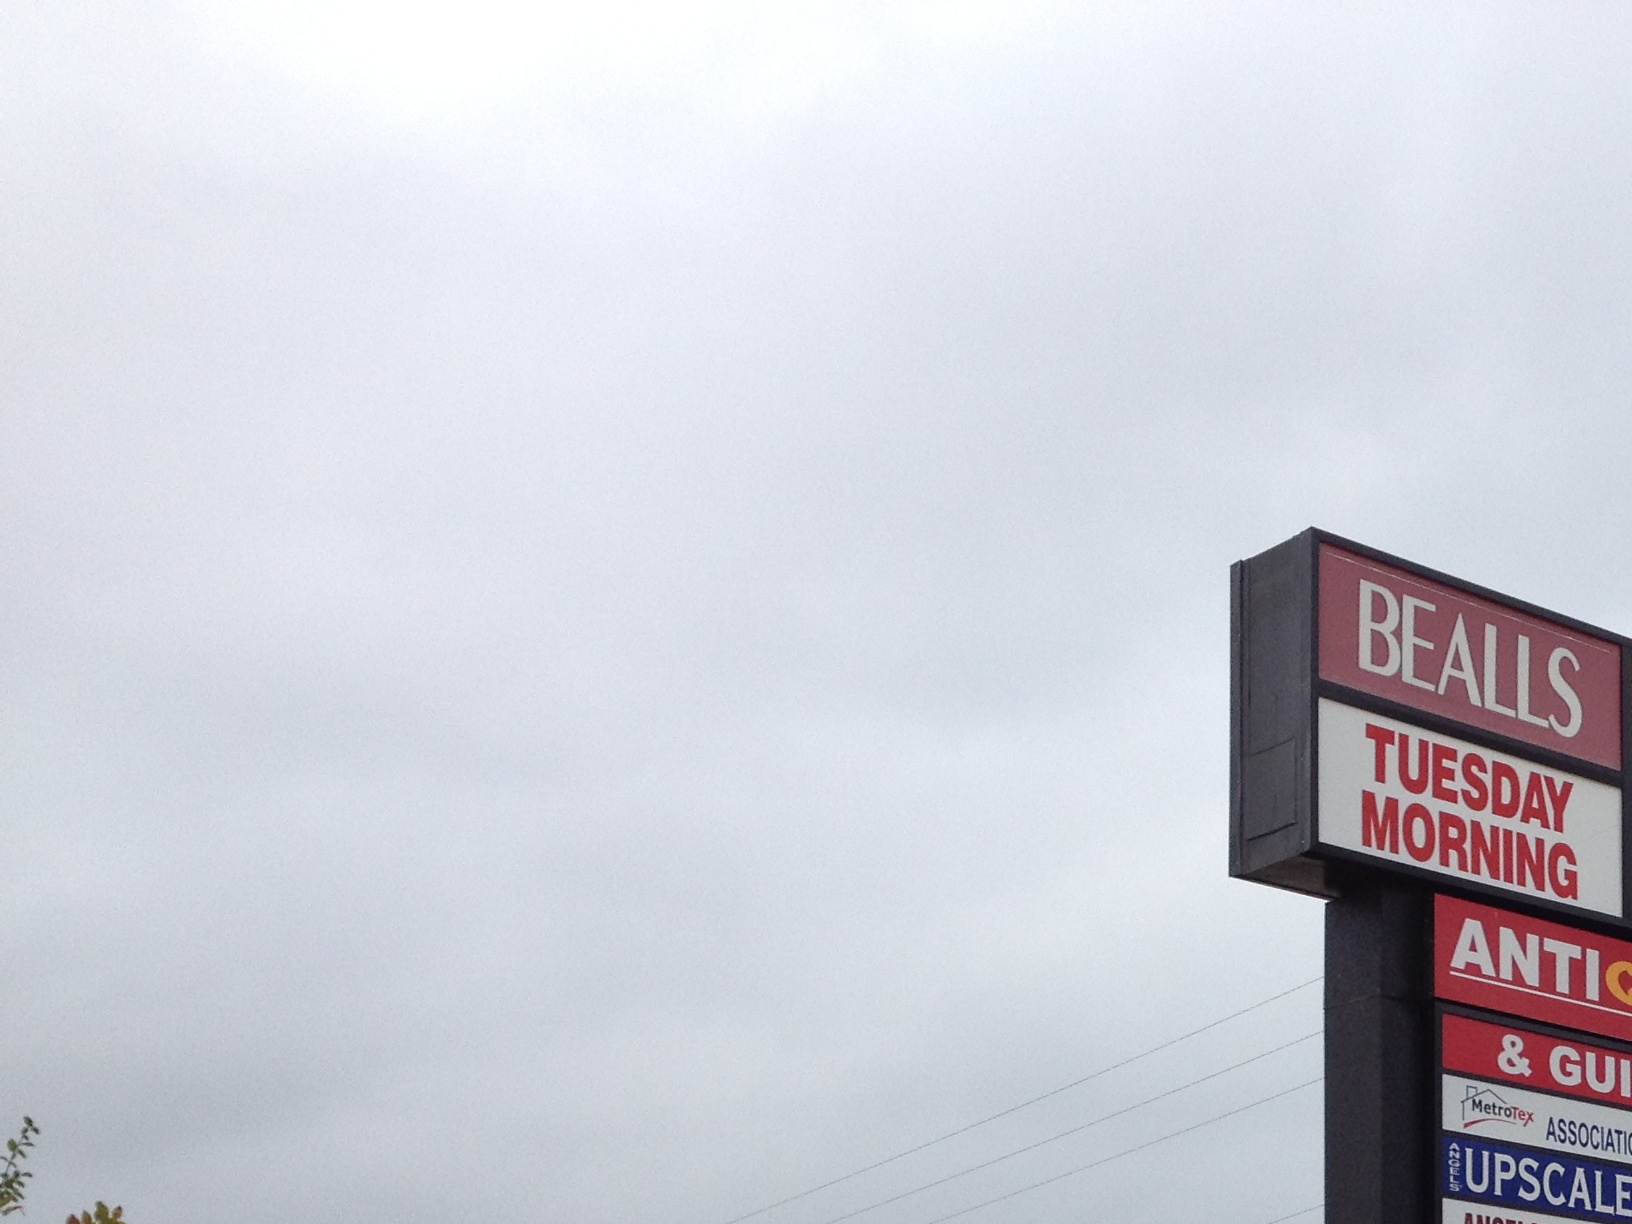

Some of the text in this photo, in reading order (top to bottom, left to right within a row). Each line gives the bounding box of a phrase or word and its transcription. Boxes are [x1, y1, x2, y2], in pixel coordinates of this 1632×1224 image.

[1357, 579, 1583, 737] BEALLS
[1365, 723, 1573, 834] TUESDAY
[1361, 790, 1578, 899] MORNING
[1497, 1034, 1532, 1076] &
[1472, 1099, 1534, 1126] MetroTex
